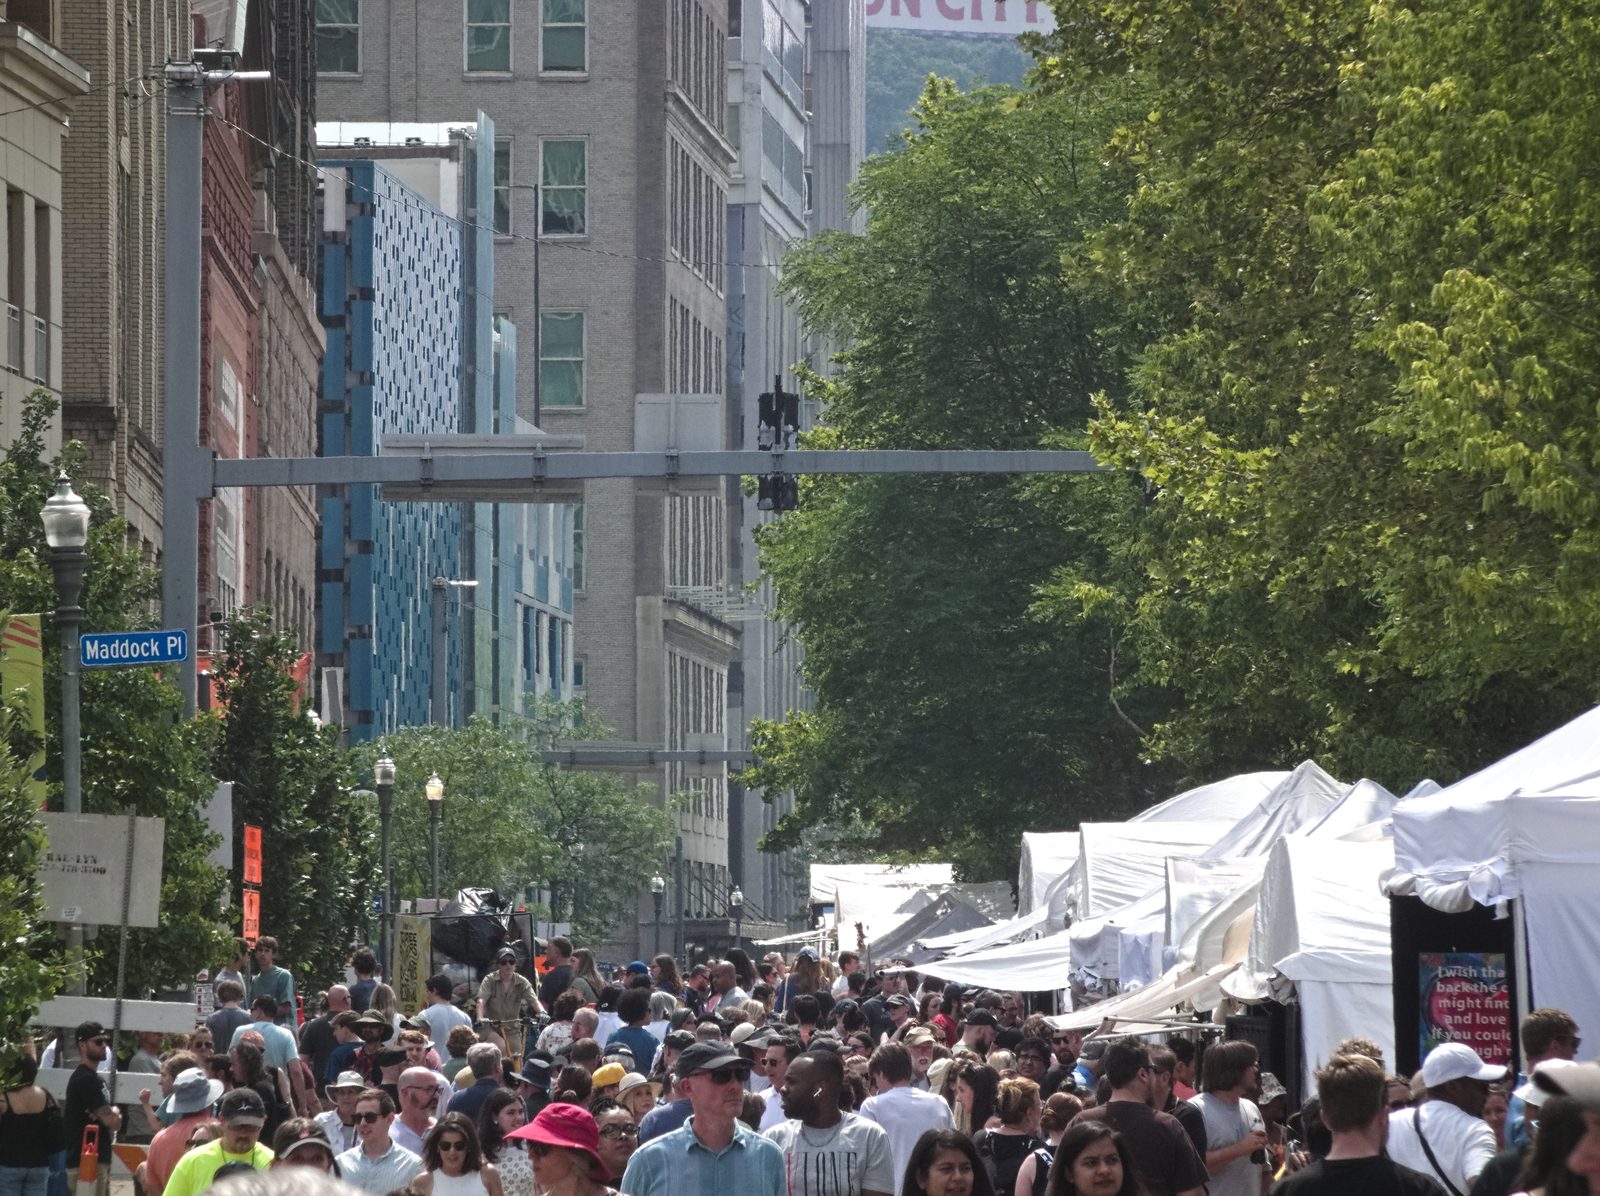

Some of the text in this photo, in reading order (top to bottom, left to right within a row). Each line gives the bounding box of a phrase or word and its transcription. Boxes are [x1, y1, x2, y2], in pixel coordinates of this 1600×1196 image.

[86, 636, 182, 660] Maddock Pl
[1445, 966, 1477, 978] wish
[1436, 981, 1470, 993] back
[1473, 982, 1497, 993] the
[1439, 997, 1481, 1011] might
[1444, 1013, 1506, 1025] and love
[1445, 1031, 1471, 1042] you
